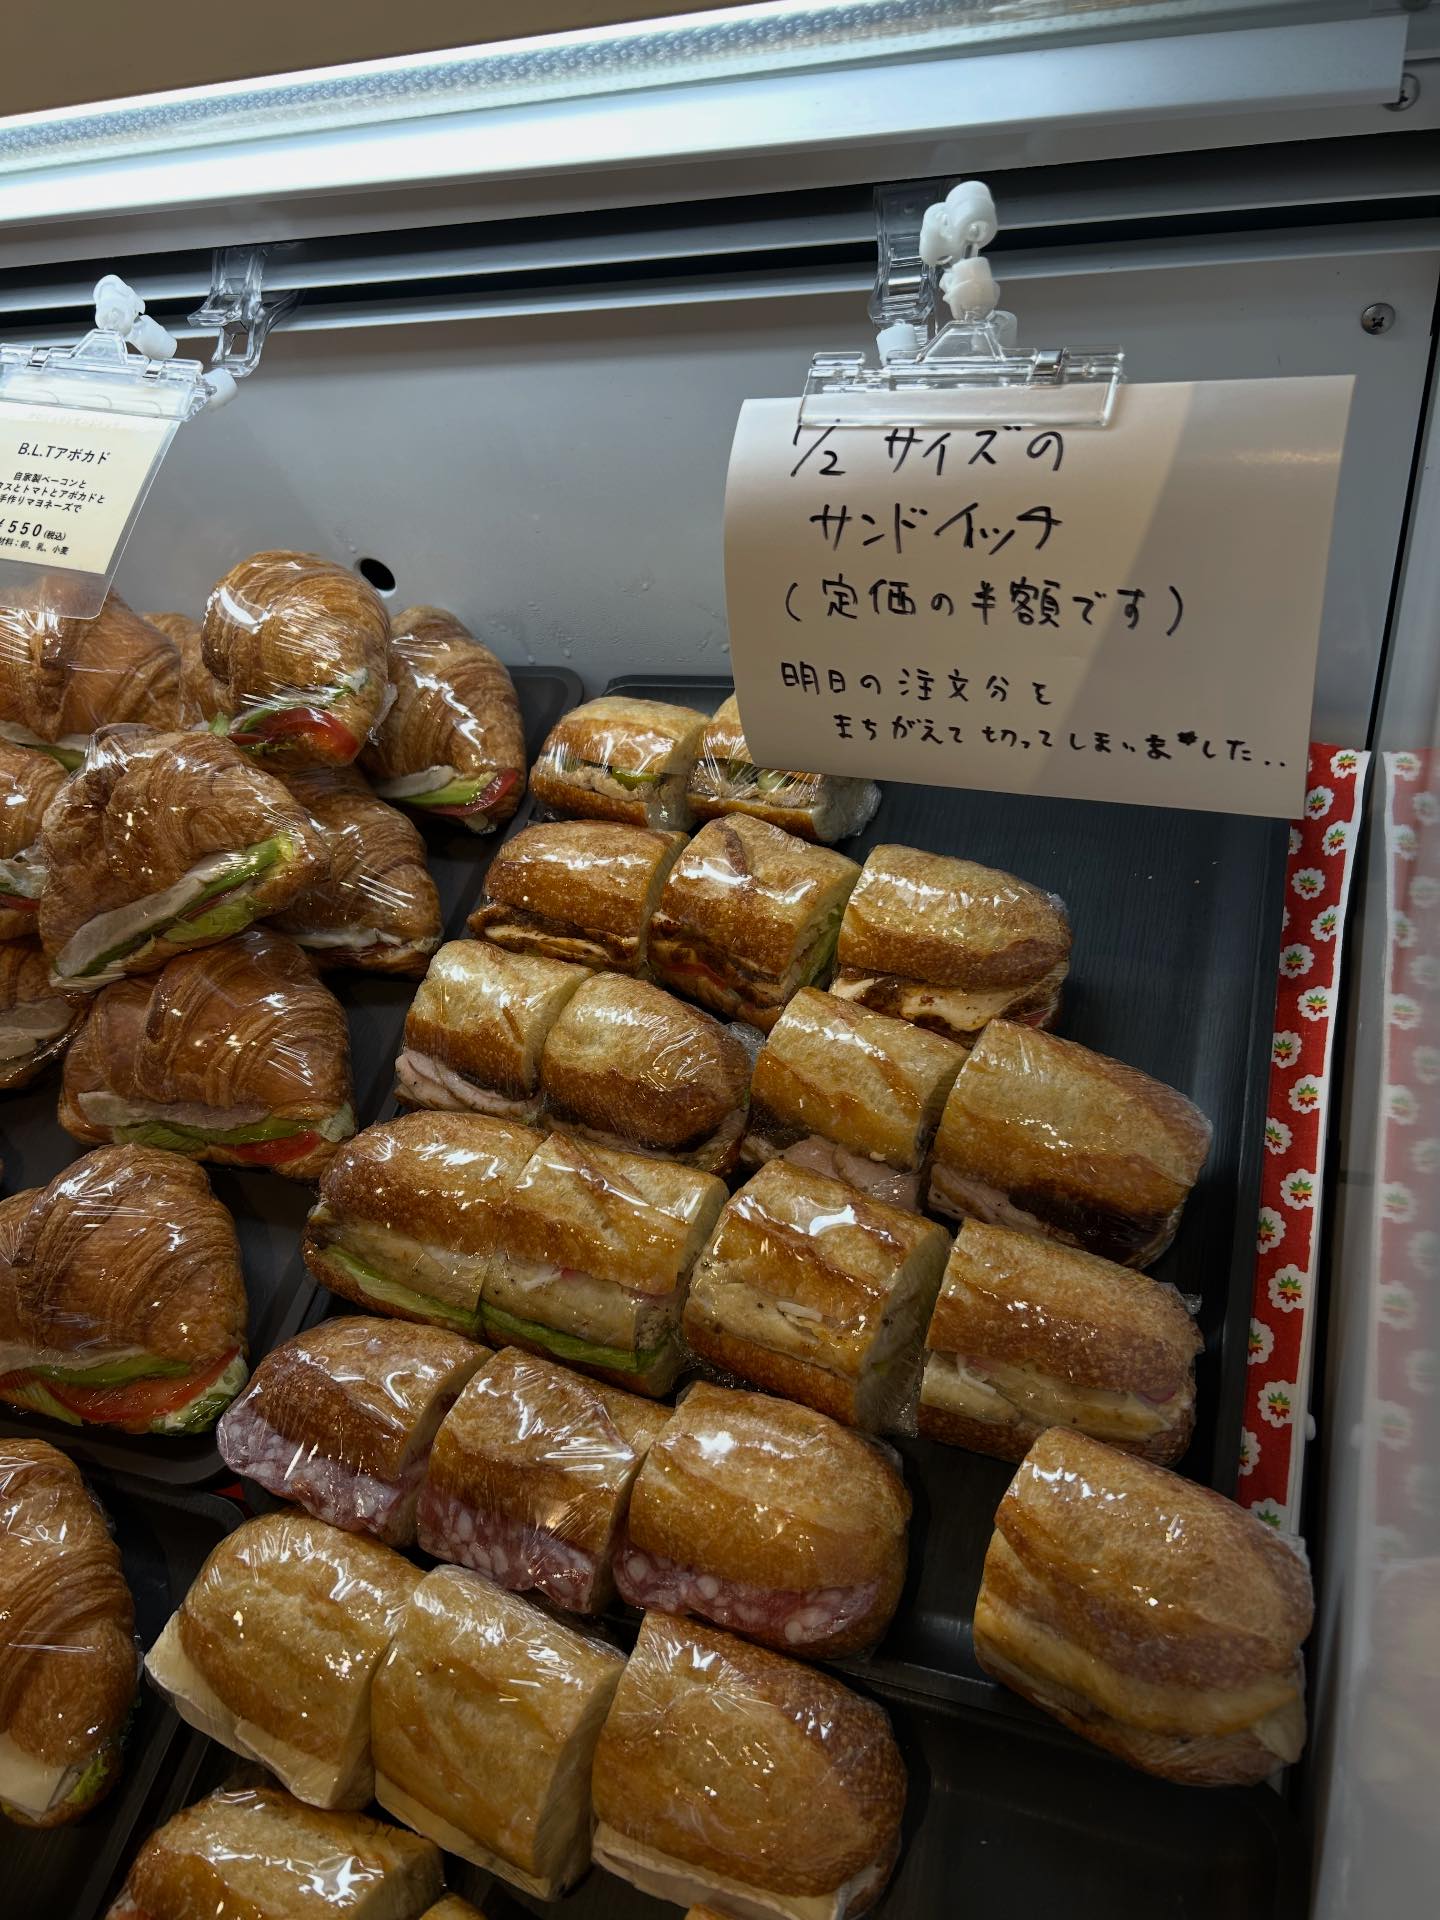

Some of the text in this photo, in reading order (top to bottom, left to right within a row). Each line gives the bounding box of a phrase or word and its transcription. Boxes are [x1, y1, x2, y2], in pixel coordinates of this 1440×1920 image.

[17, 442, 111, 465] B.L.Tアボカド
[885, 425, 1064, 476] サイズの
[13, 471, 87, 489] 自家製ベーコンと
[810, 502, 1063, 556] サンドイッチ
[785, 573, 1185, 637] (定価の半額です)
[780, 660, 1053, 706] 明日の注文分を
